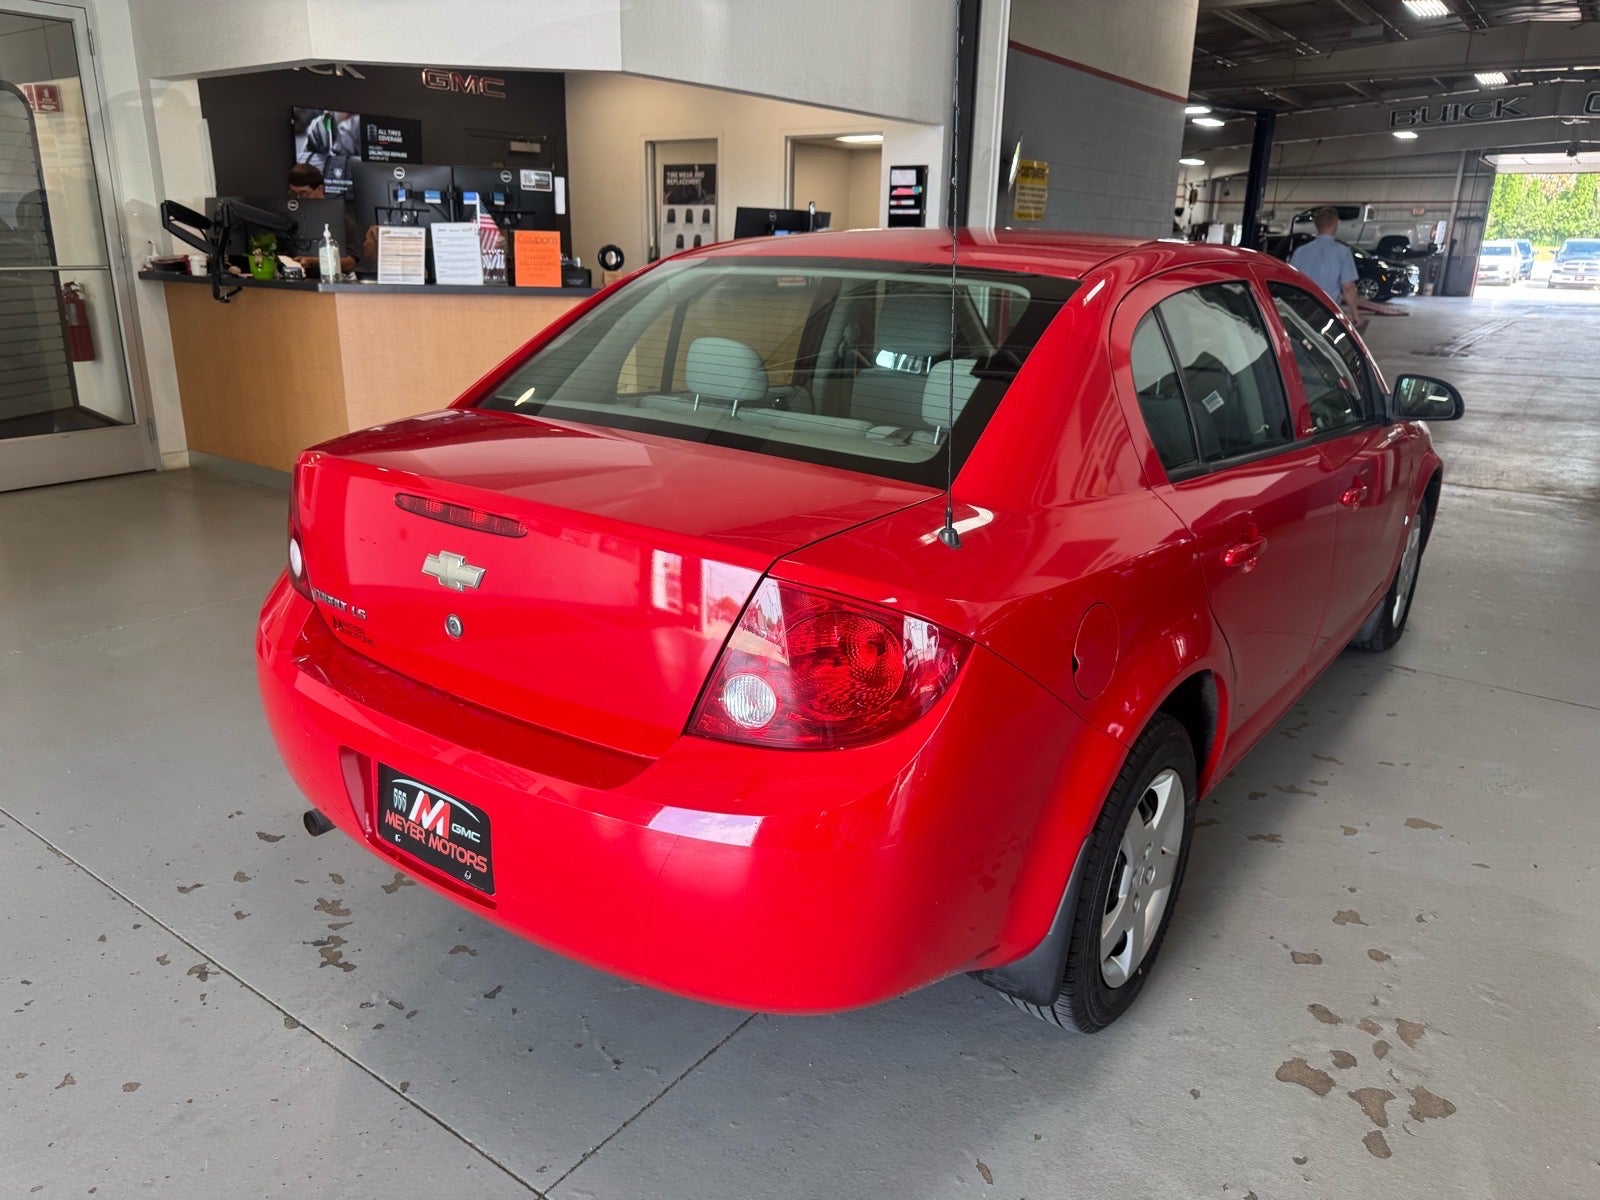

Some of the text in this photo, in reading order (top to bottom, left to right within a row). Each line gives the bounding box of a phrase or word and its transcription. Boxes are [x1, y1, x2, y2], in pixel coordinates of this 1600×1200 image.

[421, 67, 506, 99] GMC
[1389, 96, 1528, 129] BUICK
[351, 605, 367, 621] LS
[384, 809, 488, 874] MEYER MOTORS
[451, 822, 481, 844] GMC
